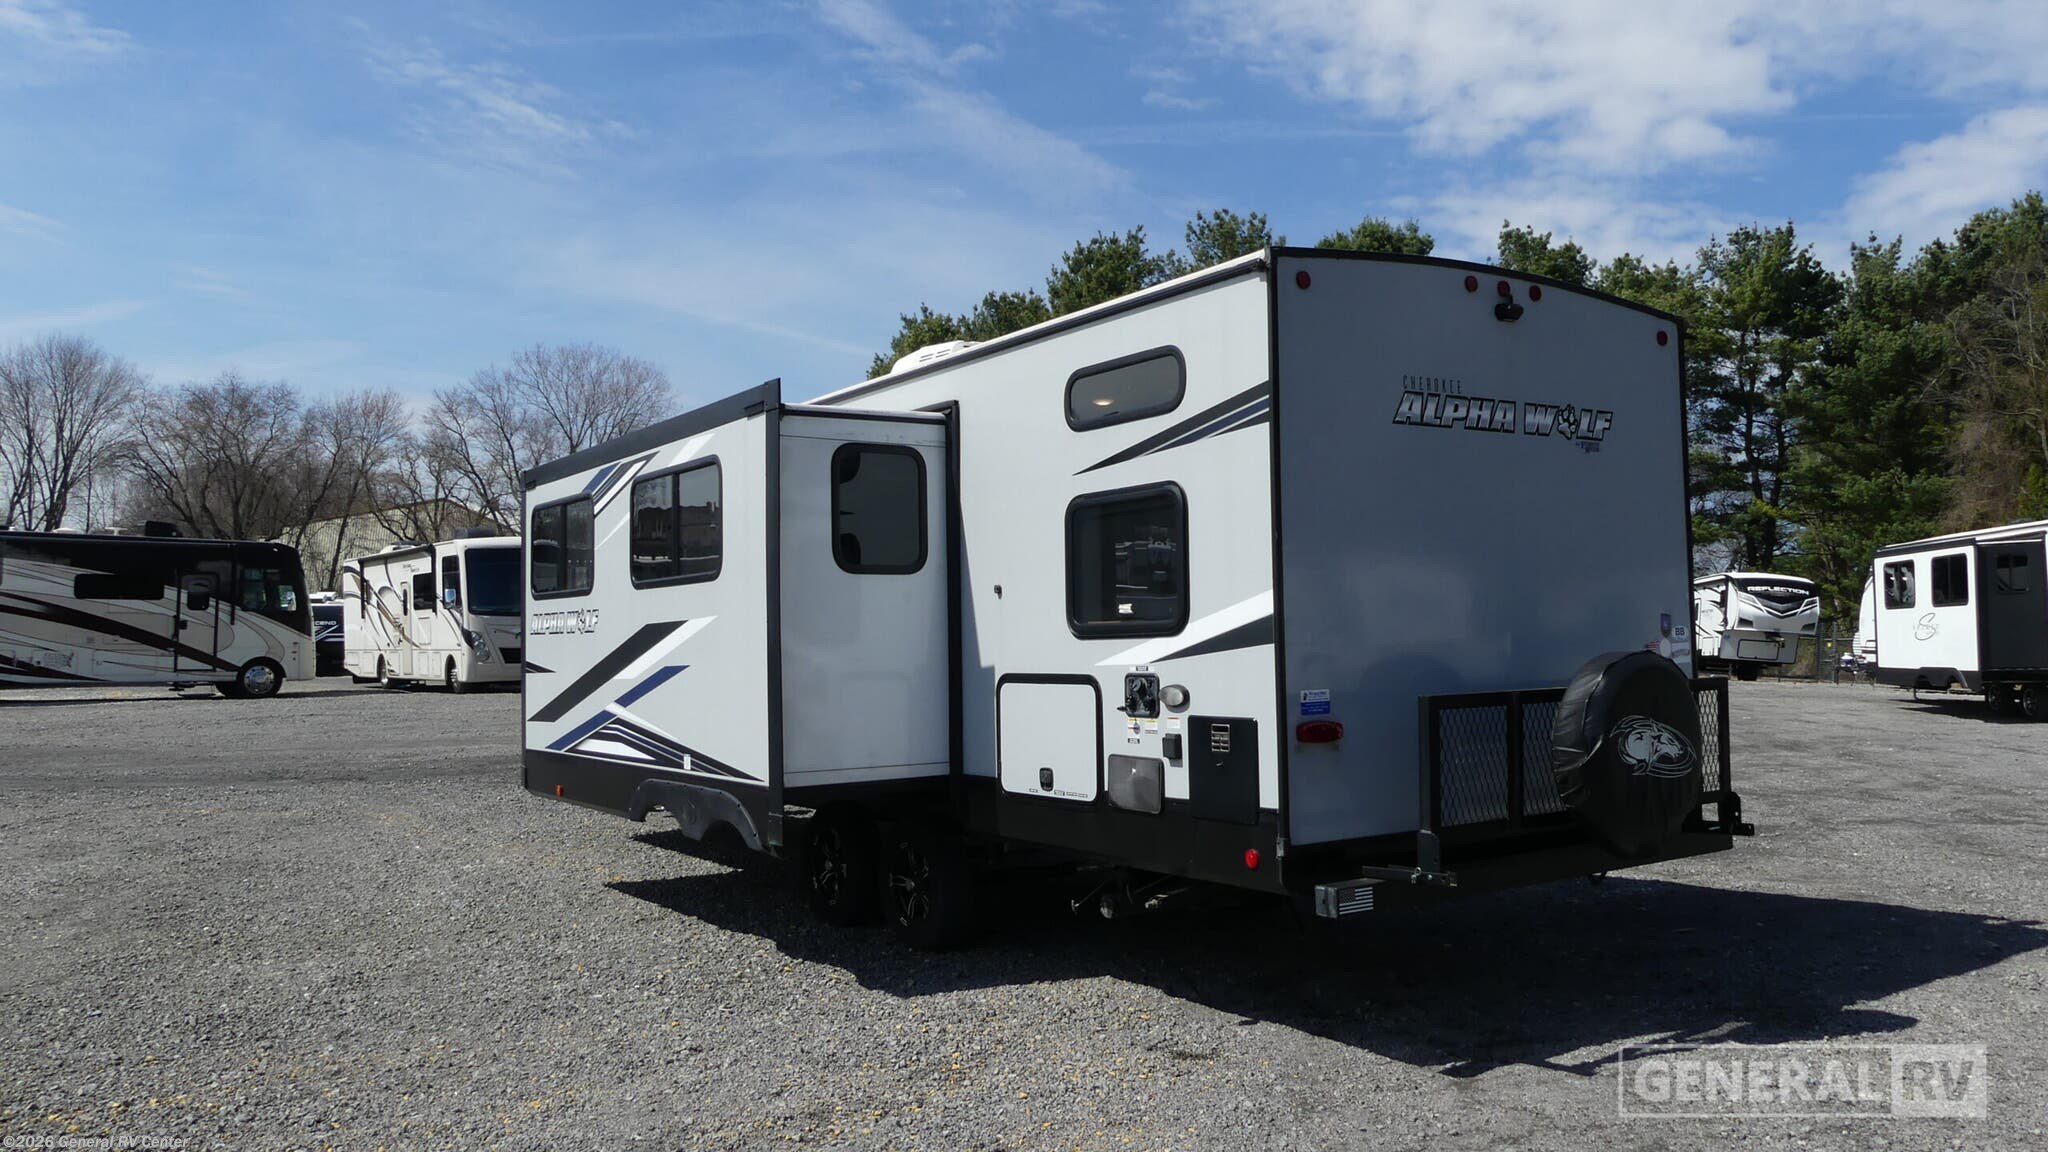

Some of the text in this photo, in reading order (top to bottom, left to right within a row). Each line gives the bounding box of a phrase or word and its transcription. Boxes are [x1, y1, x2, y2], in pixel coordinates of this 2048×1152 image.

[1402, 374, 1463, 394] CHEROKEE
[1392, 390, 1614, 442] ALPHA WOLF
[1746, 586, 1810, 596] REFLECTION
[530, 611, 565, 636] ALPHA
